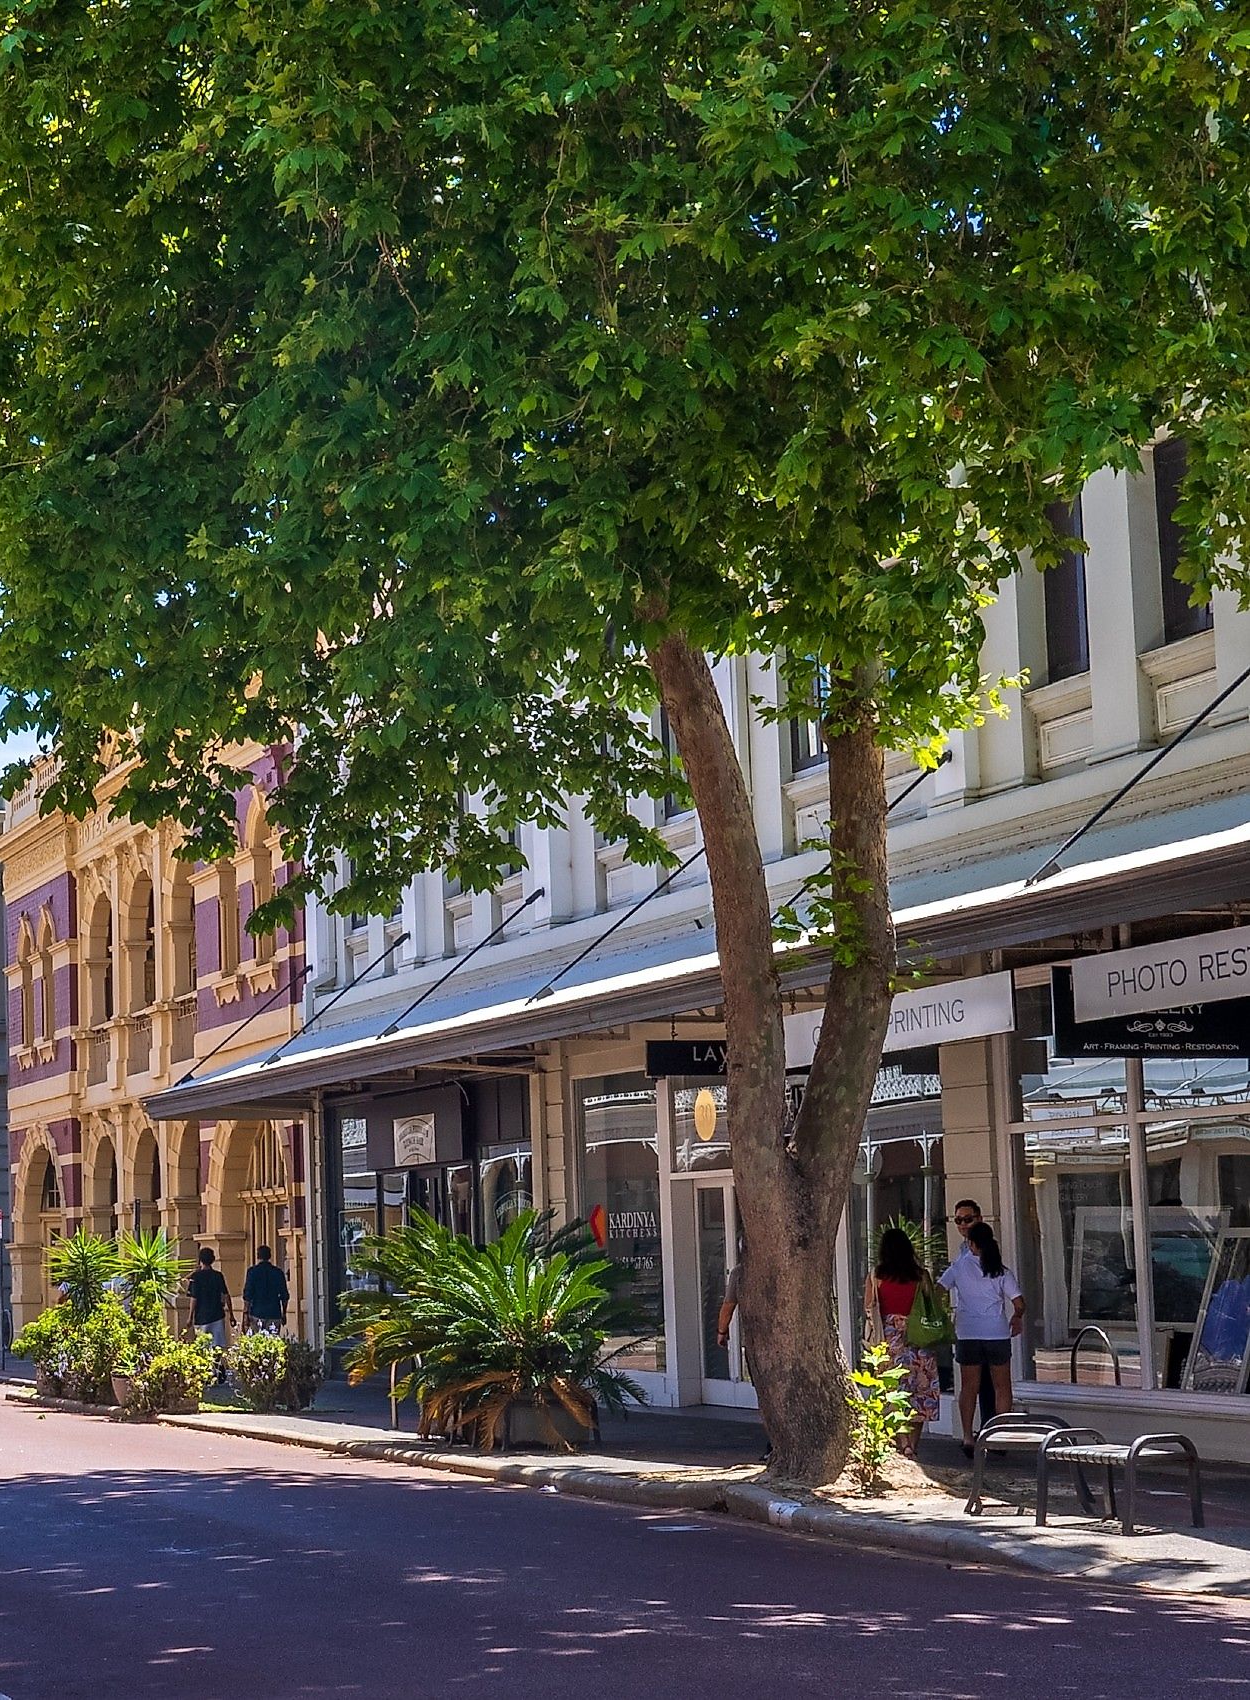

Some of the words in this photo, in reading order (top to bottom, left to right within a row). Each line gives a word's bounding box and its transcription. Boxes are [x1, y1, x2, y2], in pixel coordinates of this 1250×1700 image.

[1107, 959, 1188, 998] PHOTO
[1199, 946, 1250, 982] RES
[609, 1211, 656, 1228] KARDINYA
[609, 1228, 657, 1239] KITCHENS
